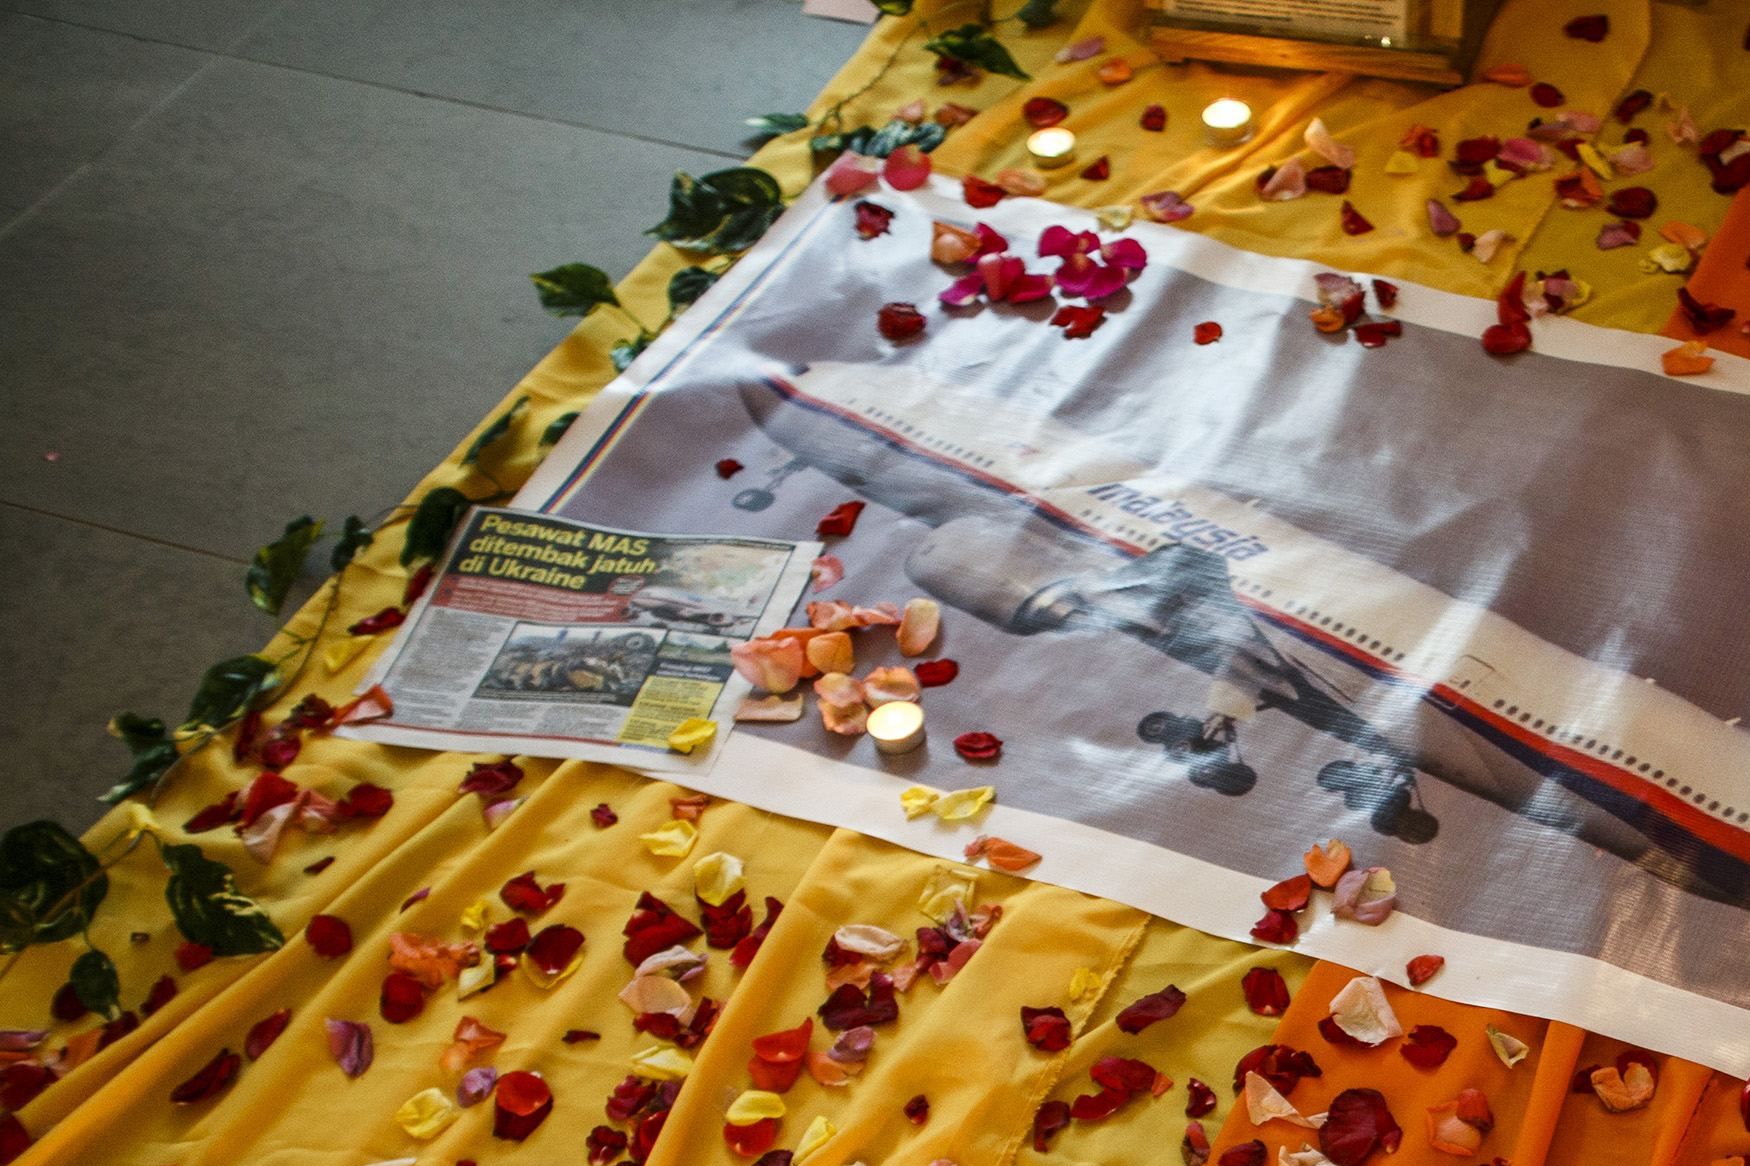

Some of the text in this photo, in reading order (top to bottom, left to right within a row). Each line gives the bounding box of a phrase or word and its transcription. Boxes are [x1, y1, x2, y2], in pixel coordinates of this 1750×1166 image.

[479, 513, 587, 547] Pesawat
[588, 533, 650, 556] MAS
[458, 554, 485, 574] di
[488, 556, 587, 590] Ukraine
[469, 535, 657, 575] ditembak jatuh
